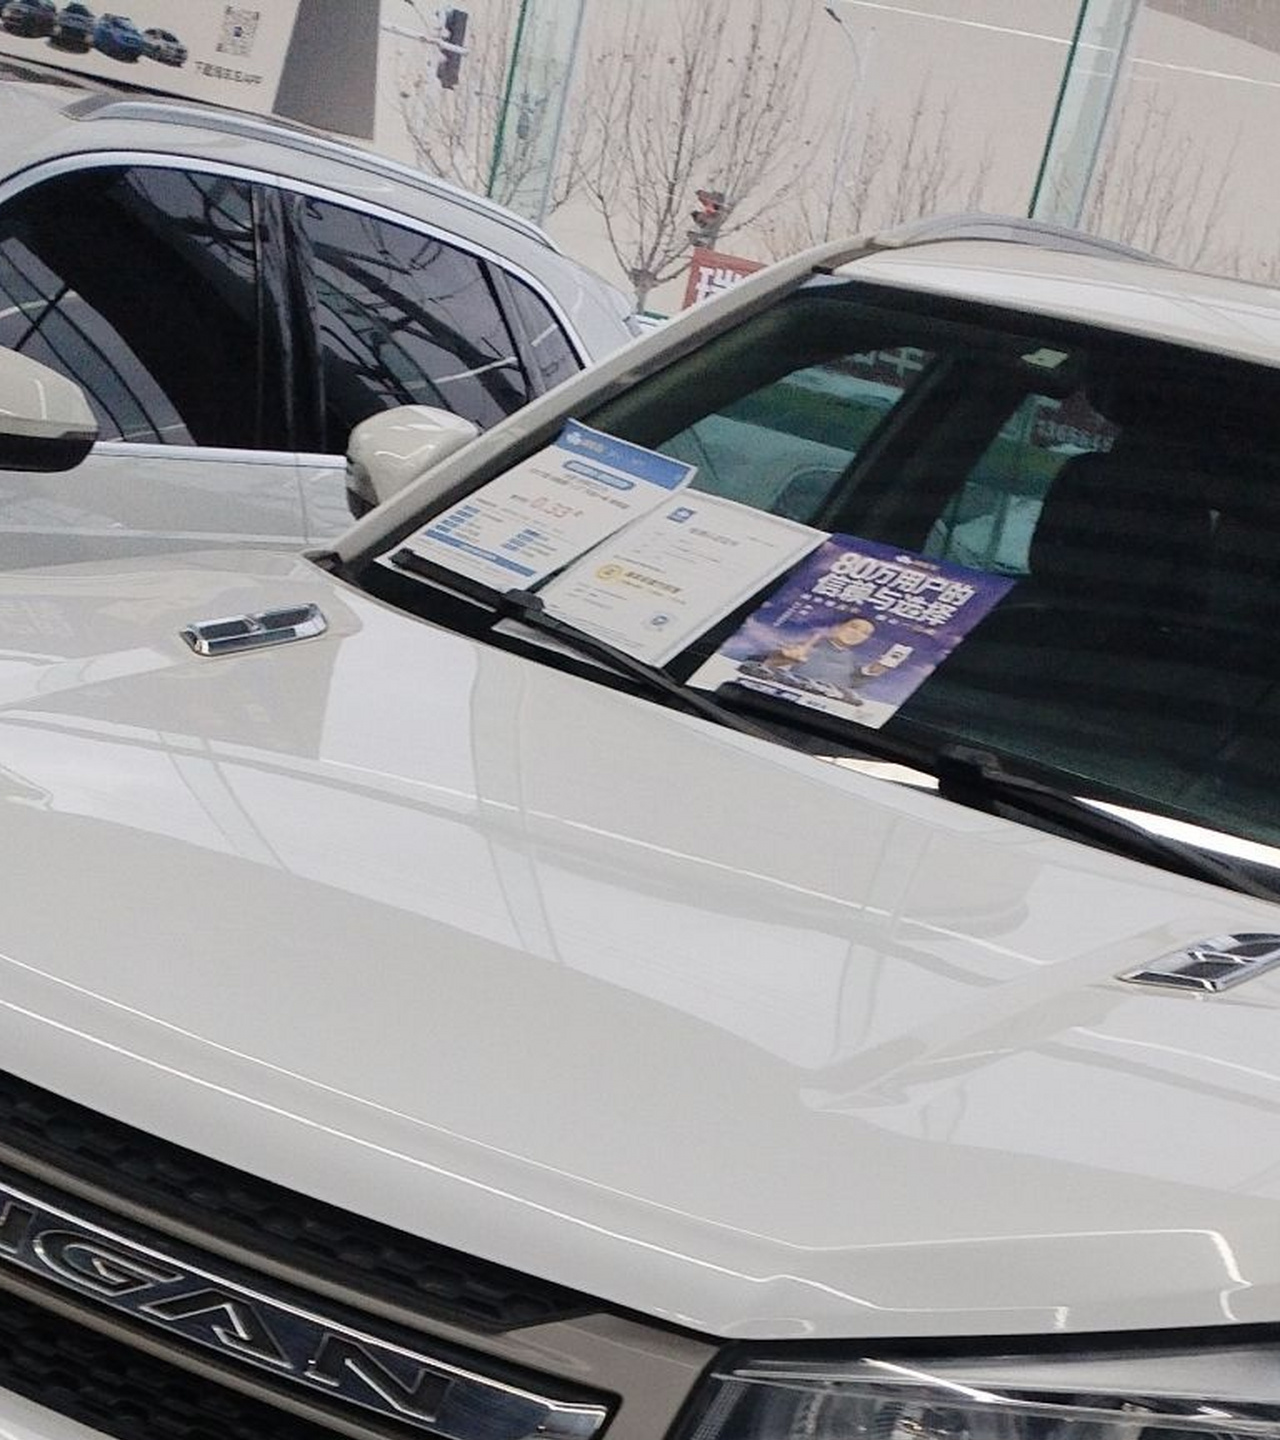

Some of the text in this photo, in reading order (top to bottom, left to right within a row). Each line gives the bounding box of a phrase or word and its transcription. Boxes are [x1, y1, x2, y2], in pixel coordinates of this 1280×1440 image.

[811, 572, 959, 626] 信赖与选择
[829, 551, 977, 606] 80万用户的
